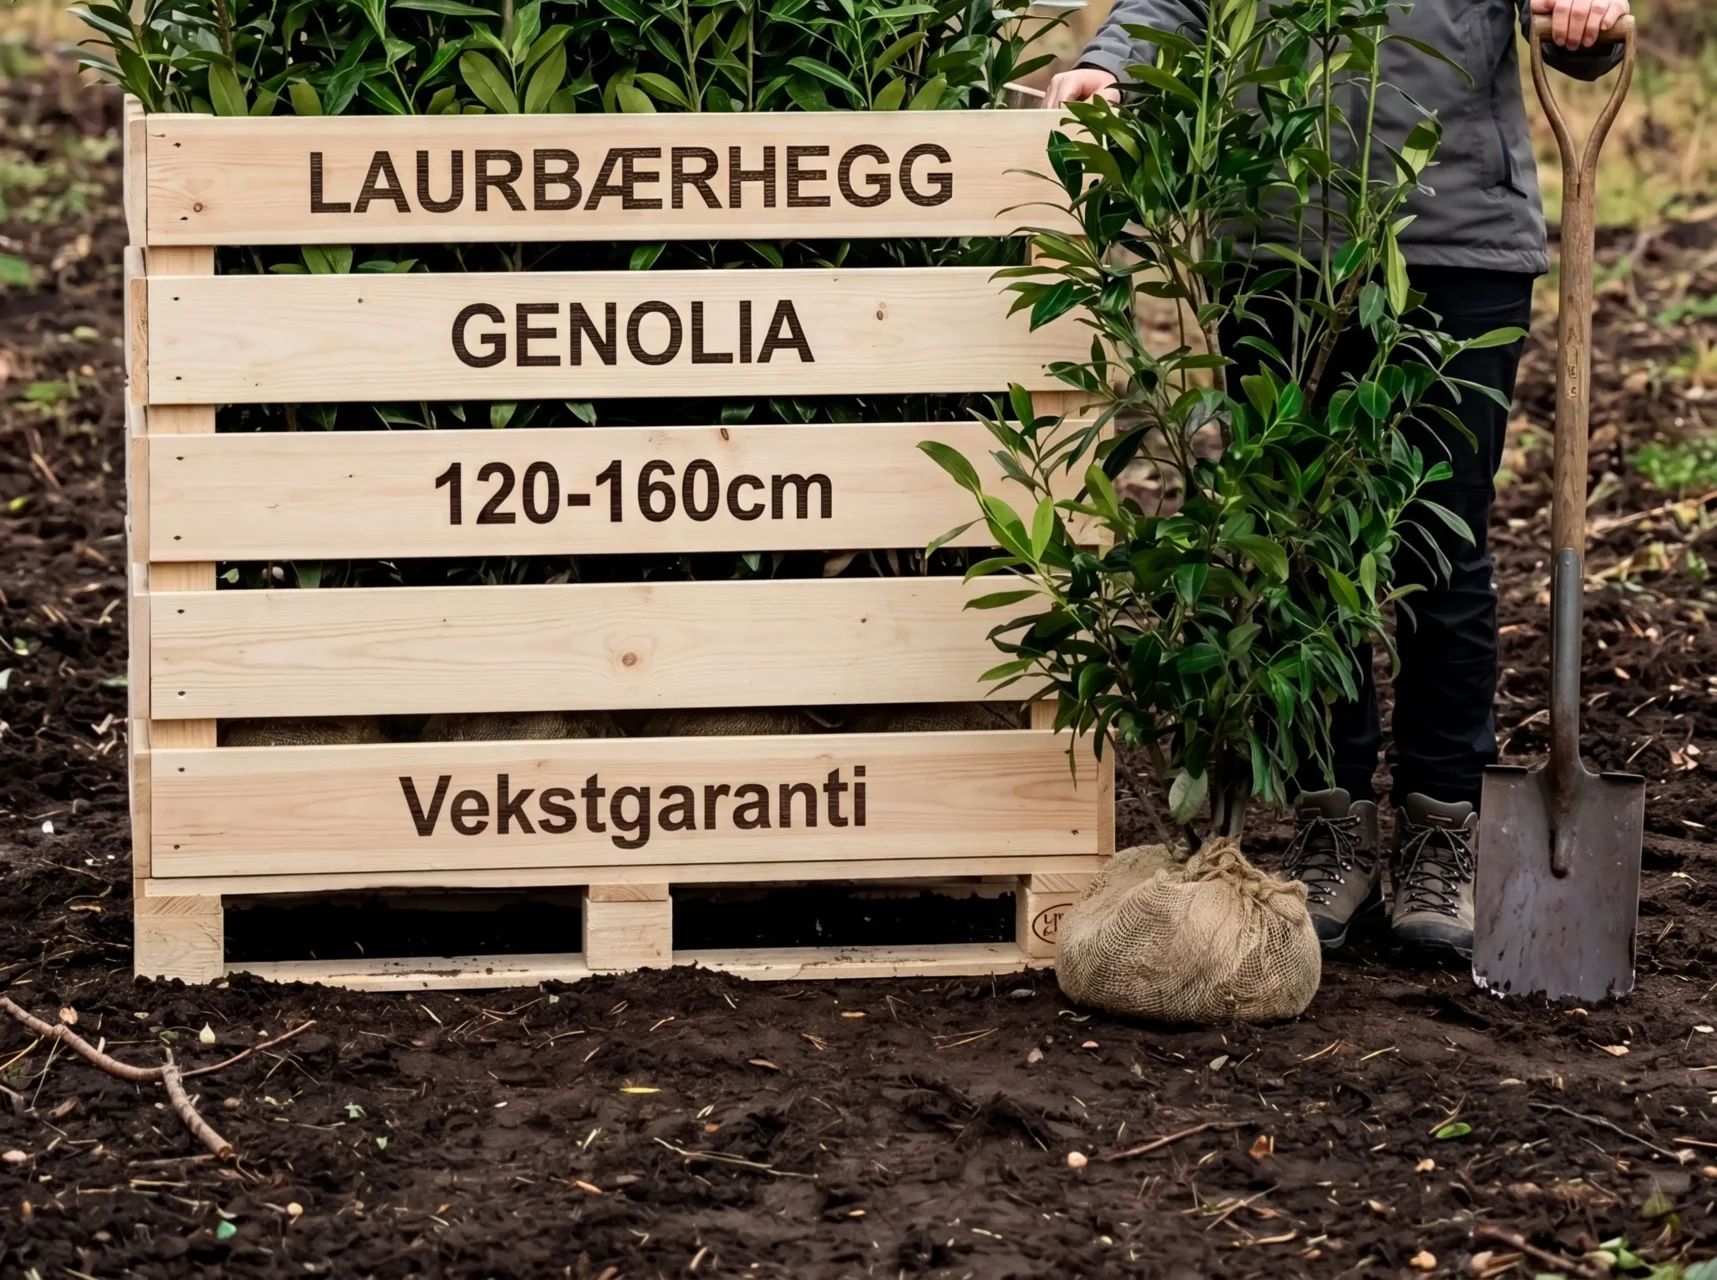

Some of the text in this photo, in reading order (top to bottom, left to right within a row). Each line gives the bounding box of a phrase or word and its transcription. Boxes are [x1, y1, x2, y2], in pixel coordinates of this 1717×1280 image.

[309, 143, 953, 214] LAURBÆRHEGG
[451, 299, 815, 369] GENOLIA
[434, 458, 834, 526] 120-160cm
[398, 765, 868, 850] Vekstgaranti
